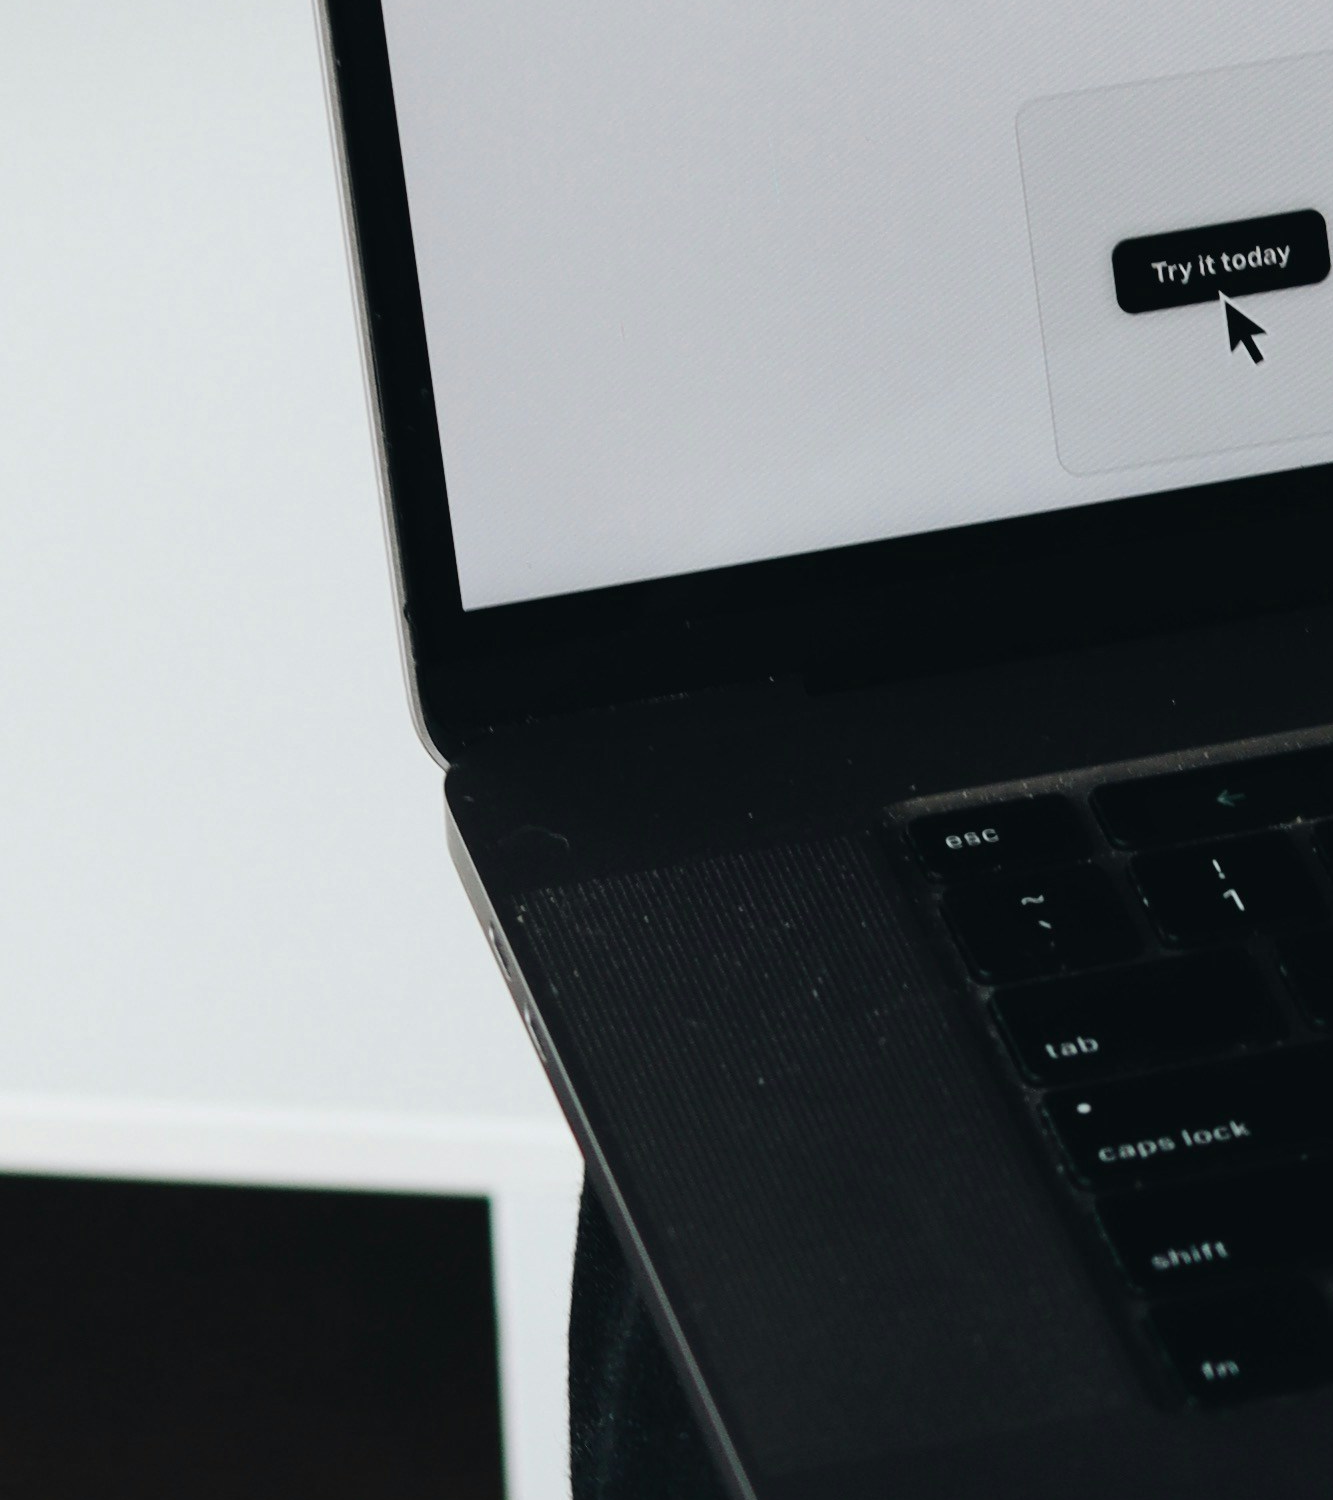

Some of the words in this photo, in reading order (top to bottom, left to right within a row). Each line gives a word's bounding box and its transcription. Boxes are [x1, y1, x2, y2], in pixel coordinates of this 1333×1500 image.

[1152, 261, 1192, 284] Try
[1199, 255, 1215, 276] it
[1221, 245, 1290, 271] today
[946, 829, 998, 848] esc
[1224, 889, 1244, 910] 1
[1046, 1037, 1098, 1058] tab
[1099, 1138, 1175, 1161] caps
[1182, 1121, 1248, 1145] lock
[1153, 1242, 1227, 1268] shift
[1202, 1362, 1238, 1378] fn
